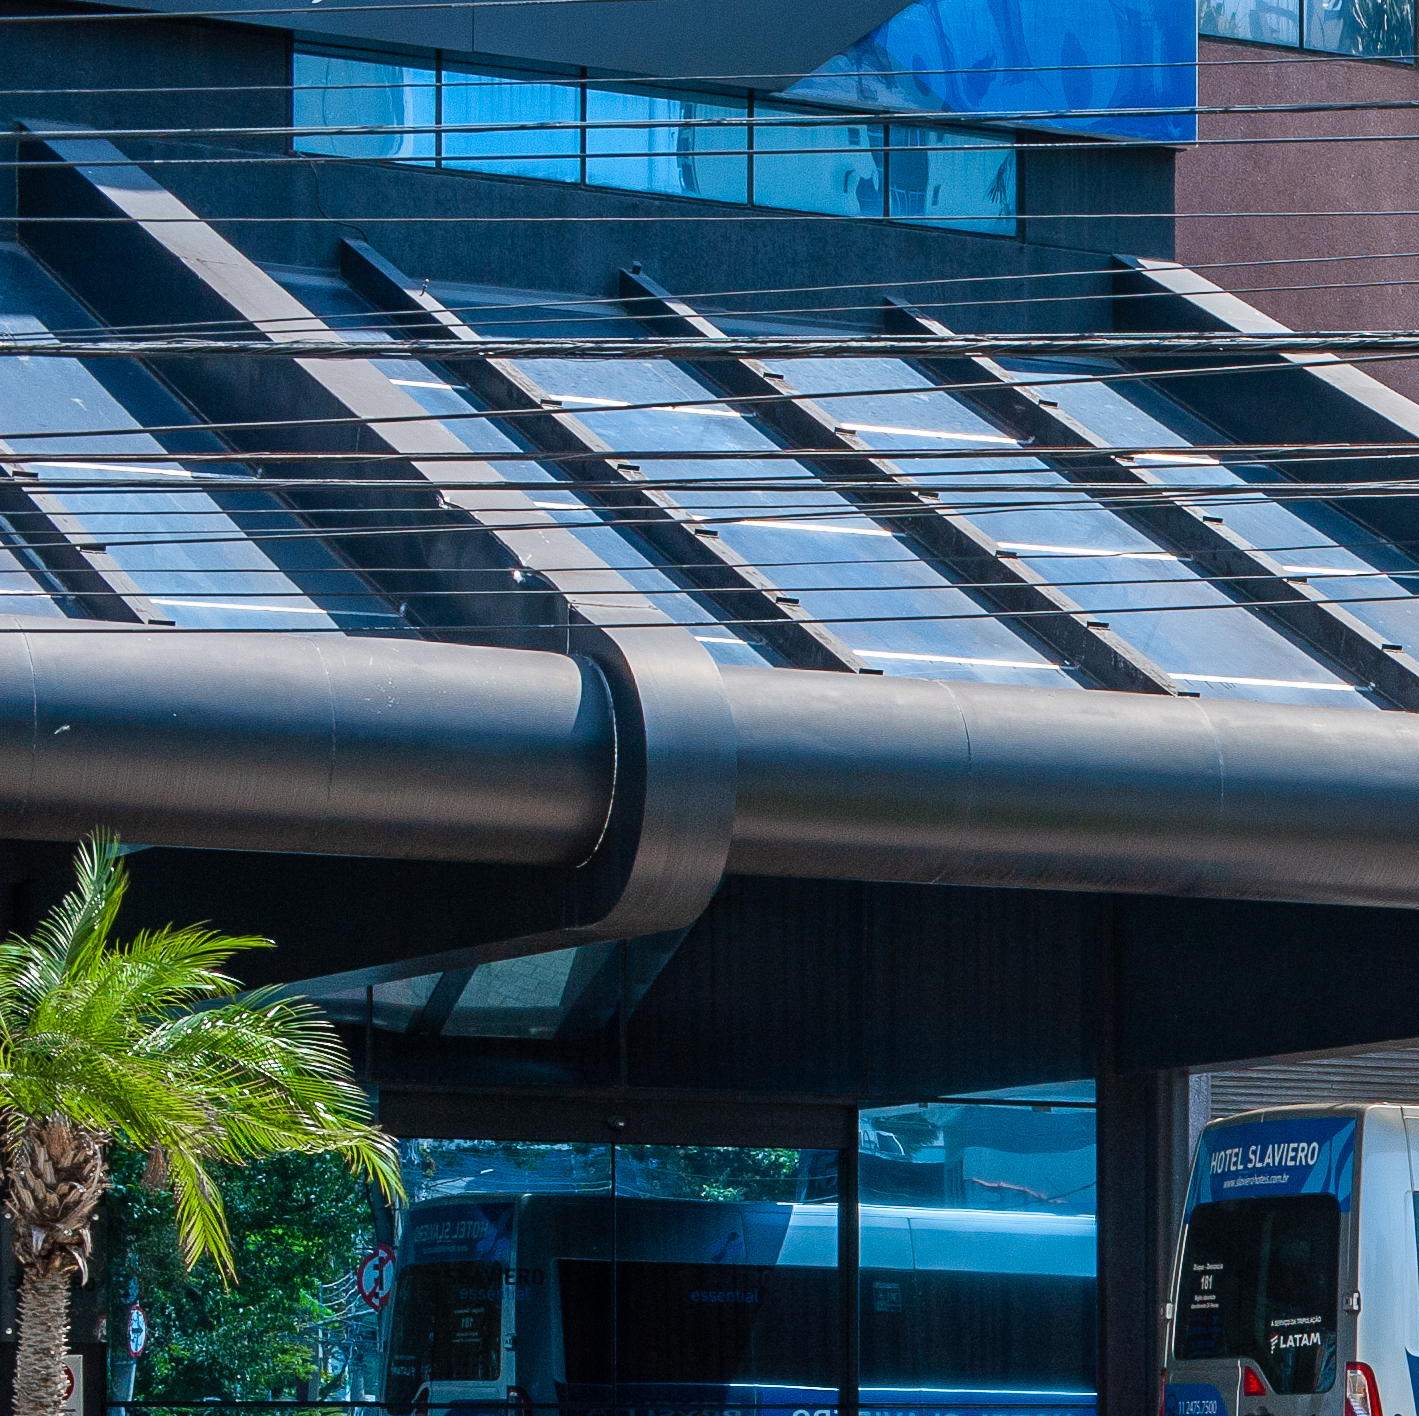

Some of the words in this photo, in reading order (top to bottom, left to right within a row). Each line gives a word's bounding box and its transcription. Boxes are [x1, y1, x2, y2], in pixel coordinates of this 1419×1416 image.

[1209, 1147, 1244, 1175] HOTEL
[1246, 1141, 1319, 1171] SLAVIERO
[690, 1288, 760, 1304] essential
[1279, 1332, 1321, 1349] LATAM
